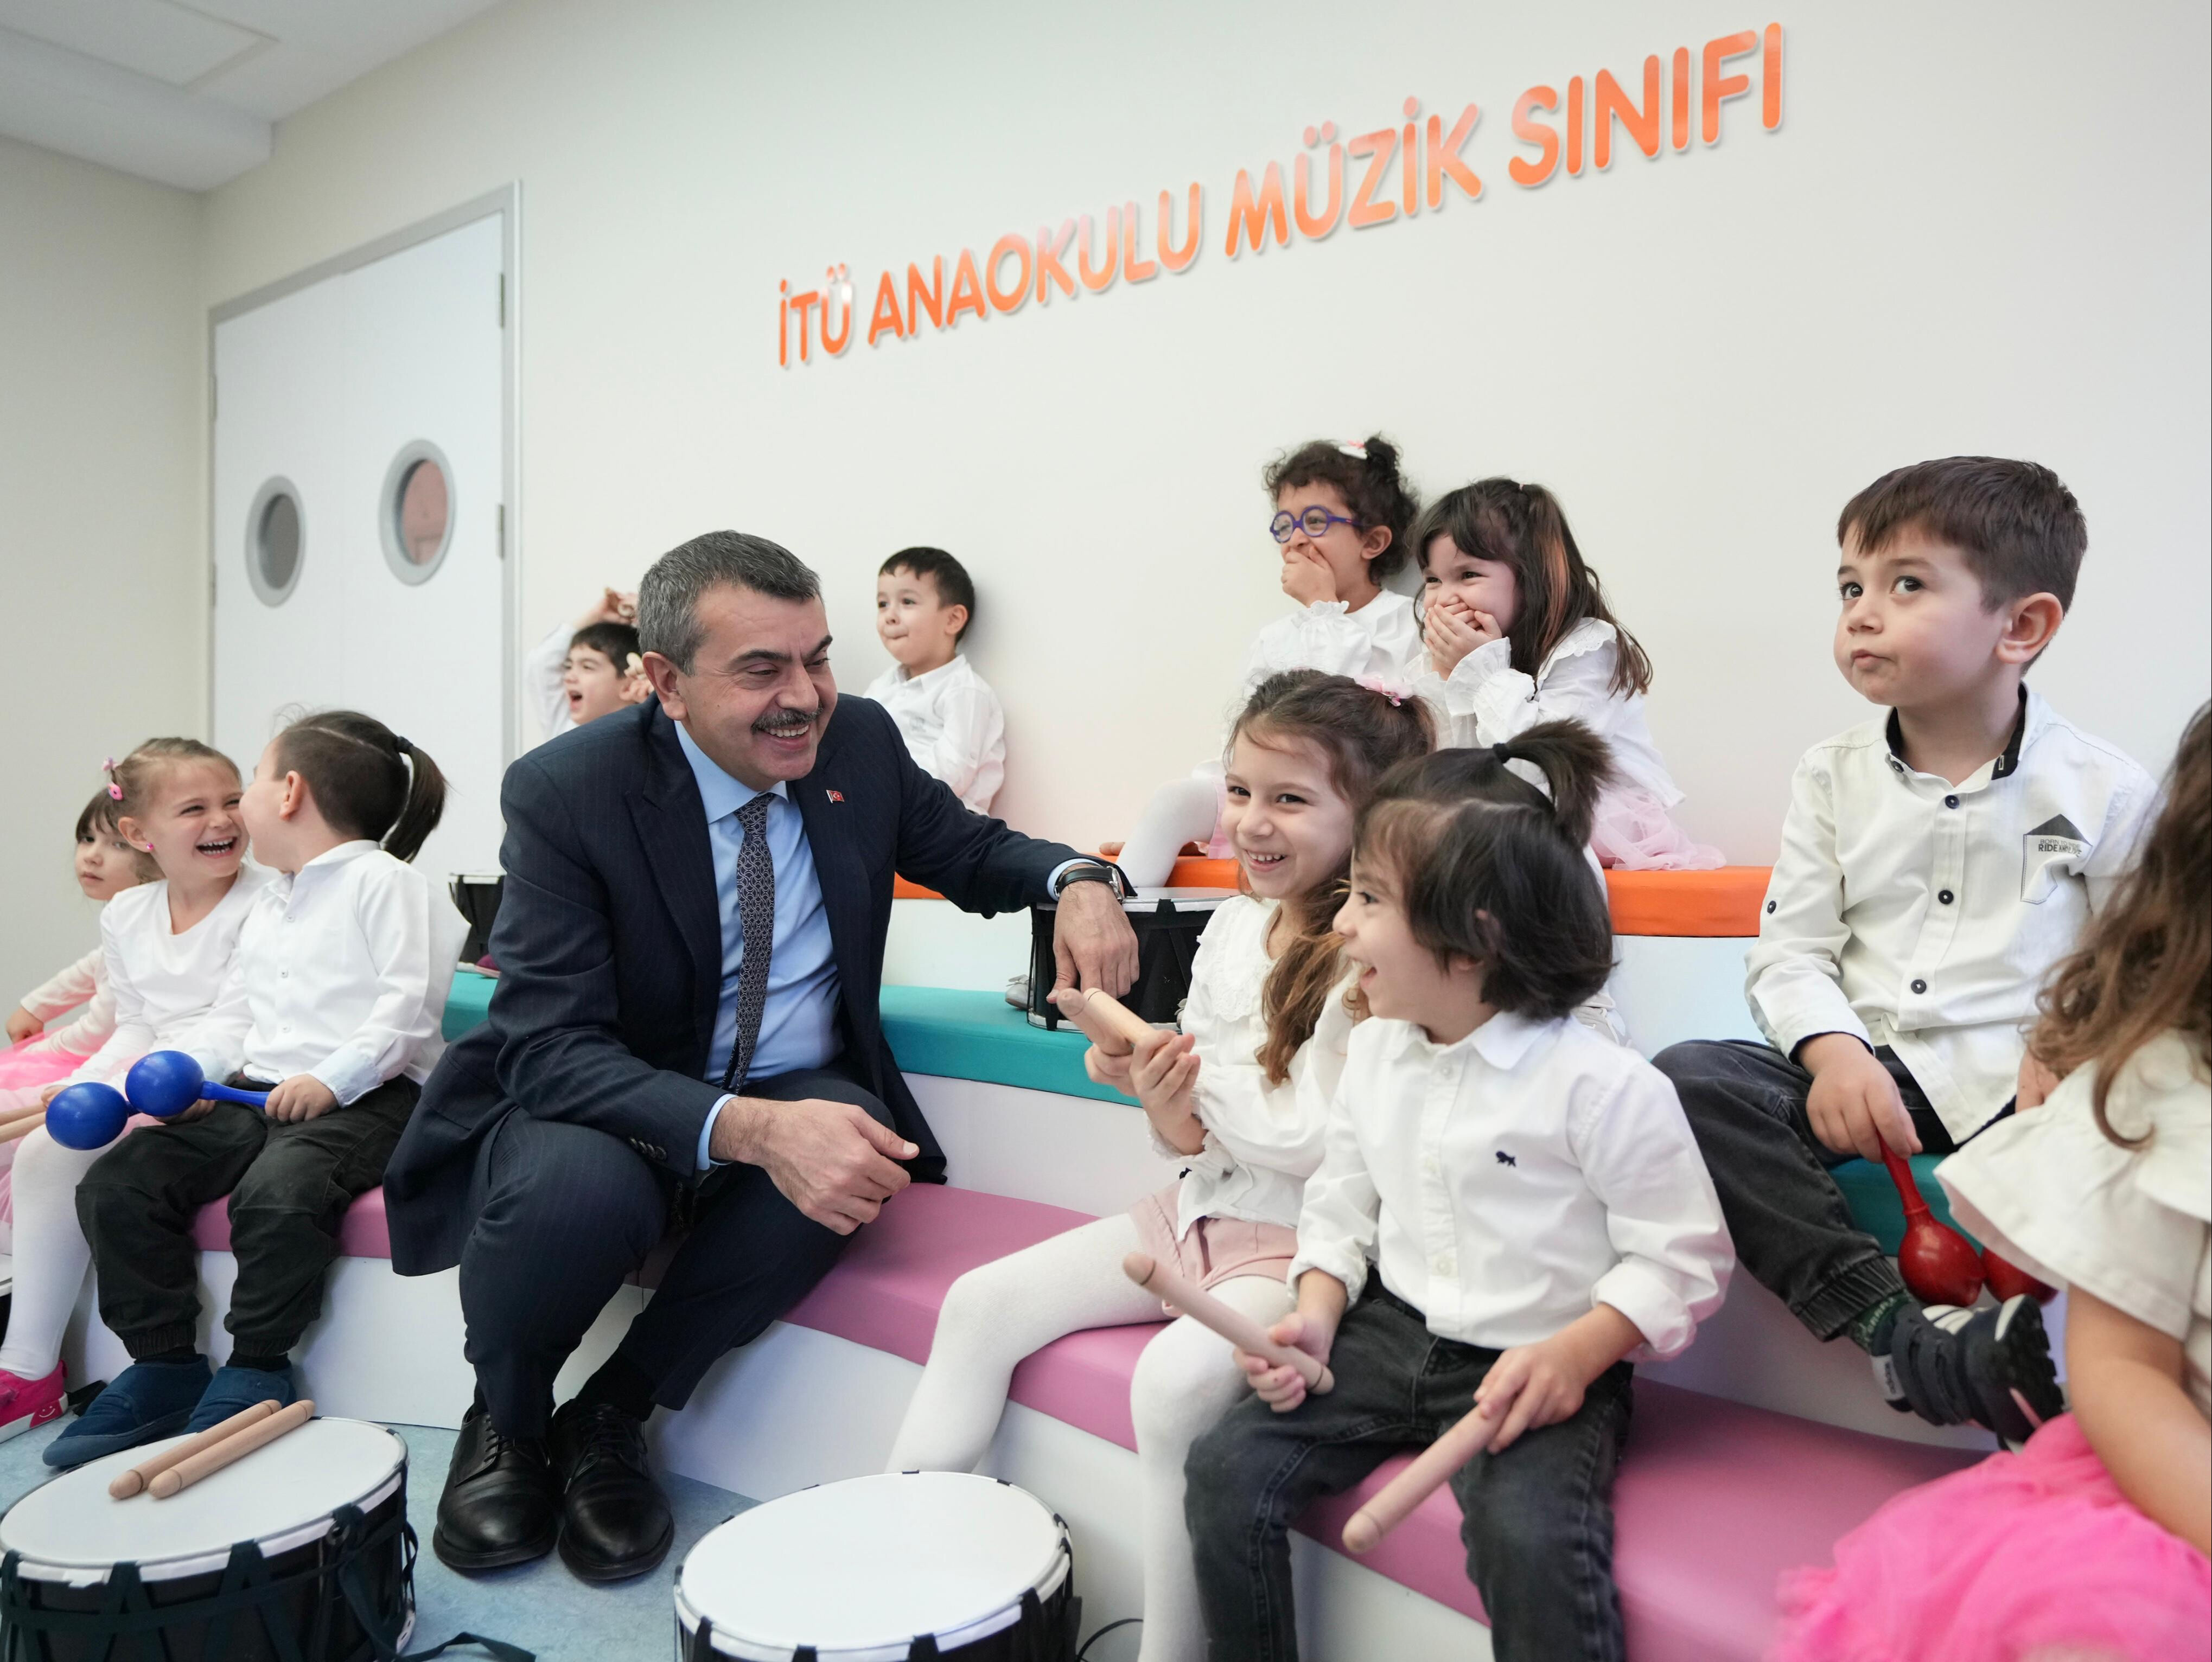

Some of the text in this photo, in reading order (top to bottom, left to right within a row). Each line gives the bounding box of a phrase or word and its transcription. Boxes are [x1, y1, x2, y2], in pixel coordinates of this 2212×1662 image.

[778, 20, 1784, 368] İTÜ ANAOKULU MÜZİK SINIFI
